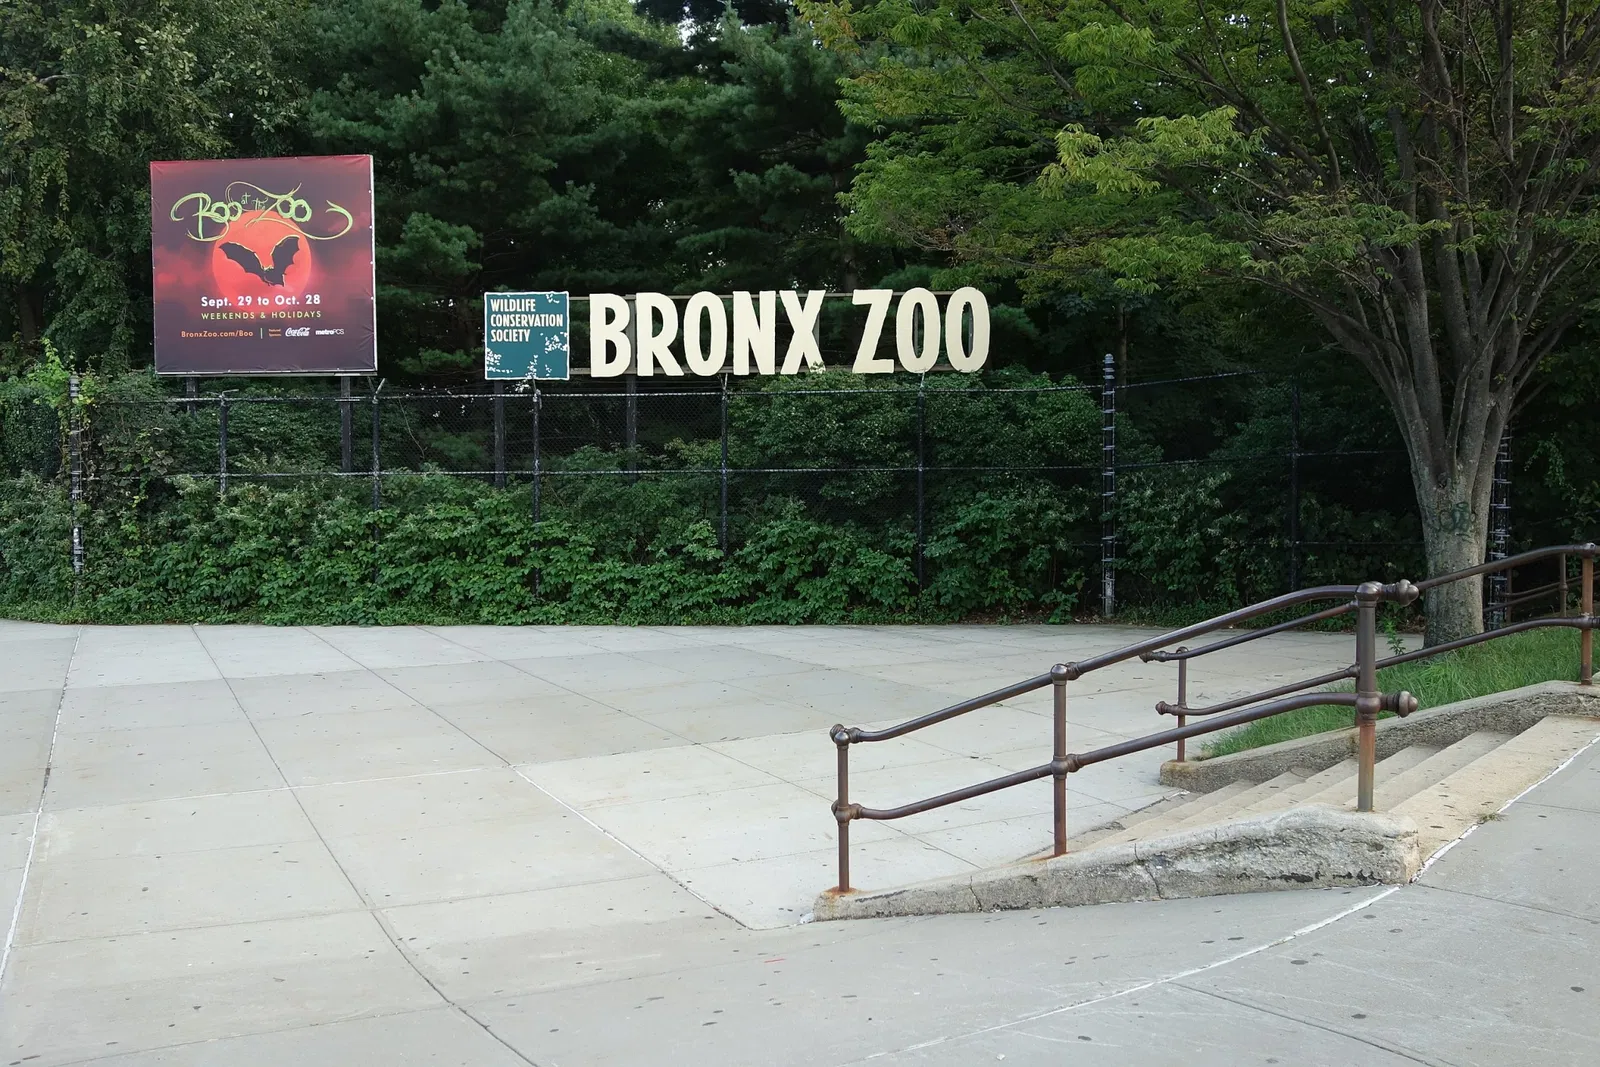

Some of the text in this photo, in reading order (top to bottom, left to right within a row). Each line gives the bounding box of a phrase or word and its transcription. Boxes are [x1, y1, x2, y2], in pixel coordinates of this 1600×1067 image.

[170, 192, 242, 241] Boo
[201, 294, 321, 309] Sept. 29 to Oct. 28
[490, 299, 536, 312] WILDLIFE
[201, 310, 322, 320] WEEKENDS & HOLIDAYS
[490, 314, 563, 327] CONSERVATION
[181, 330, 254, 338] BronxZoo.com/Boo
[490, 329, 531, 342] SOCIETY
[589, 286, 990, 378] BRONX ZOO
